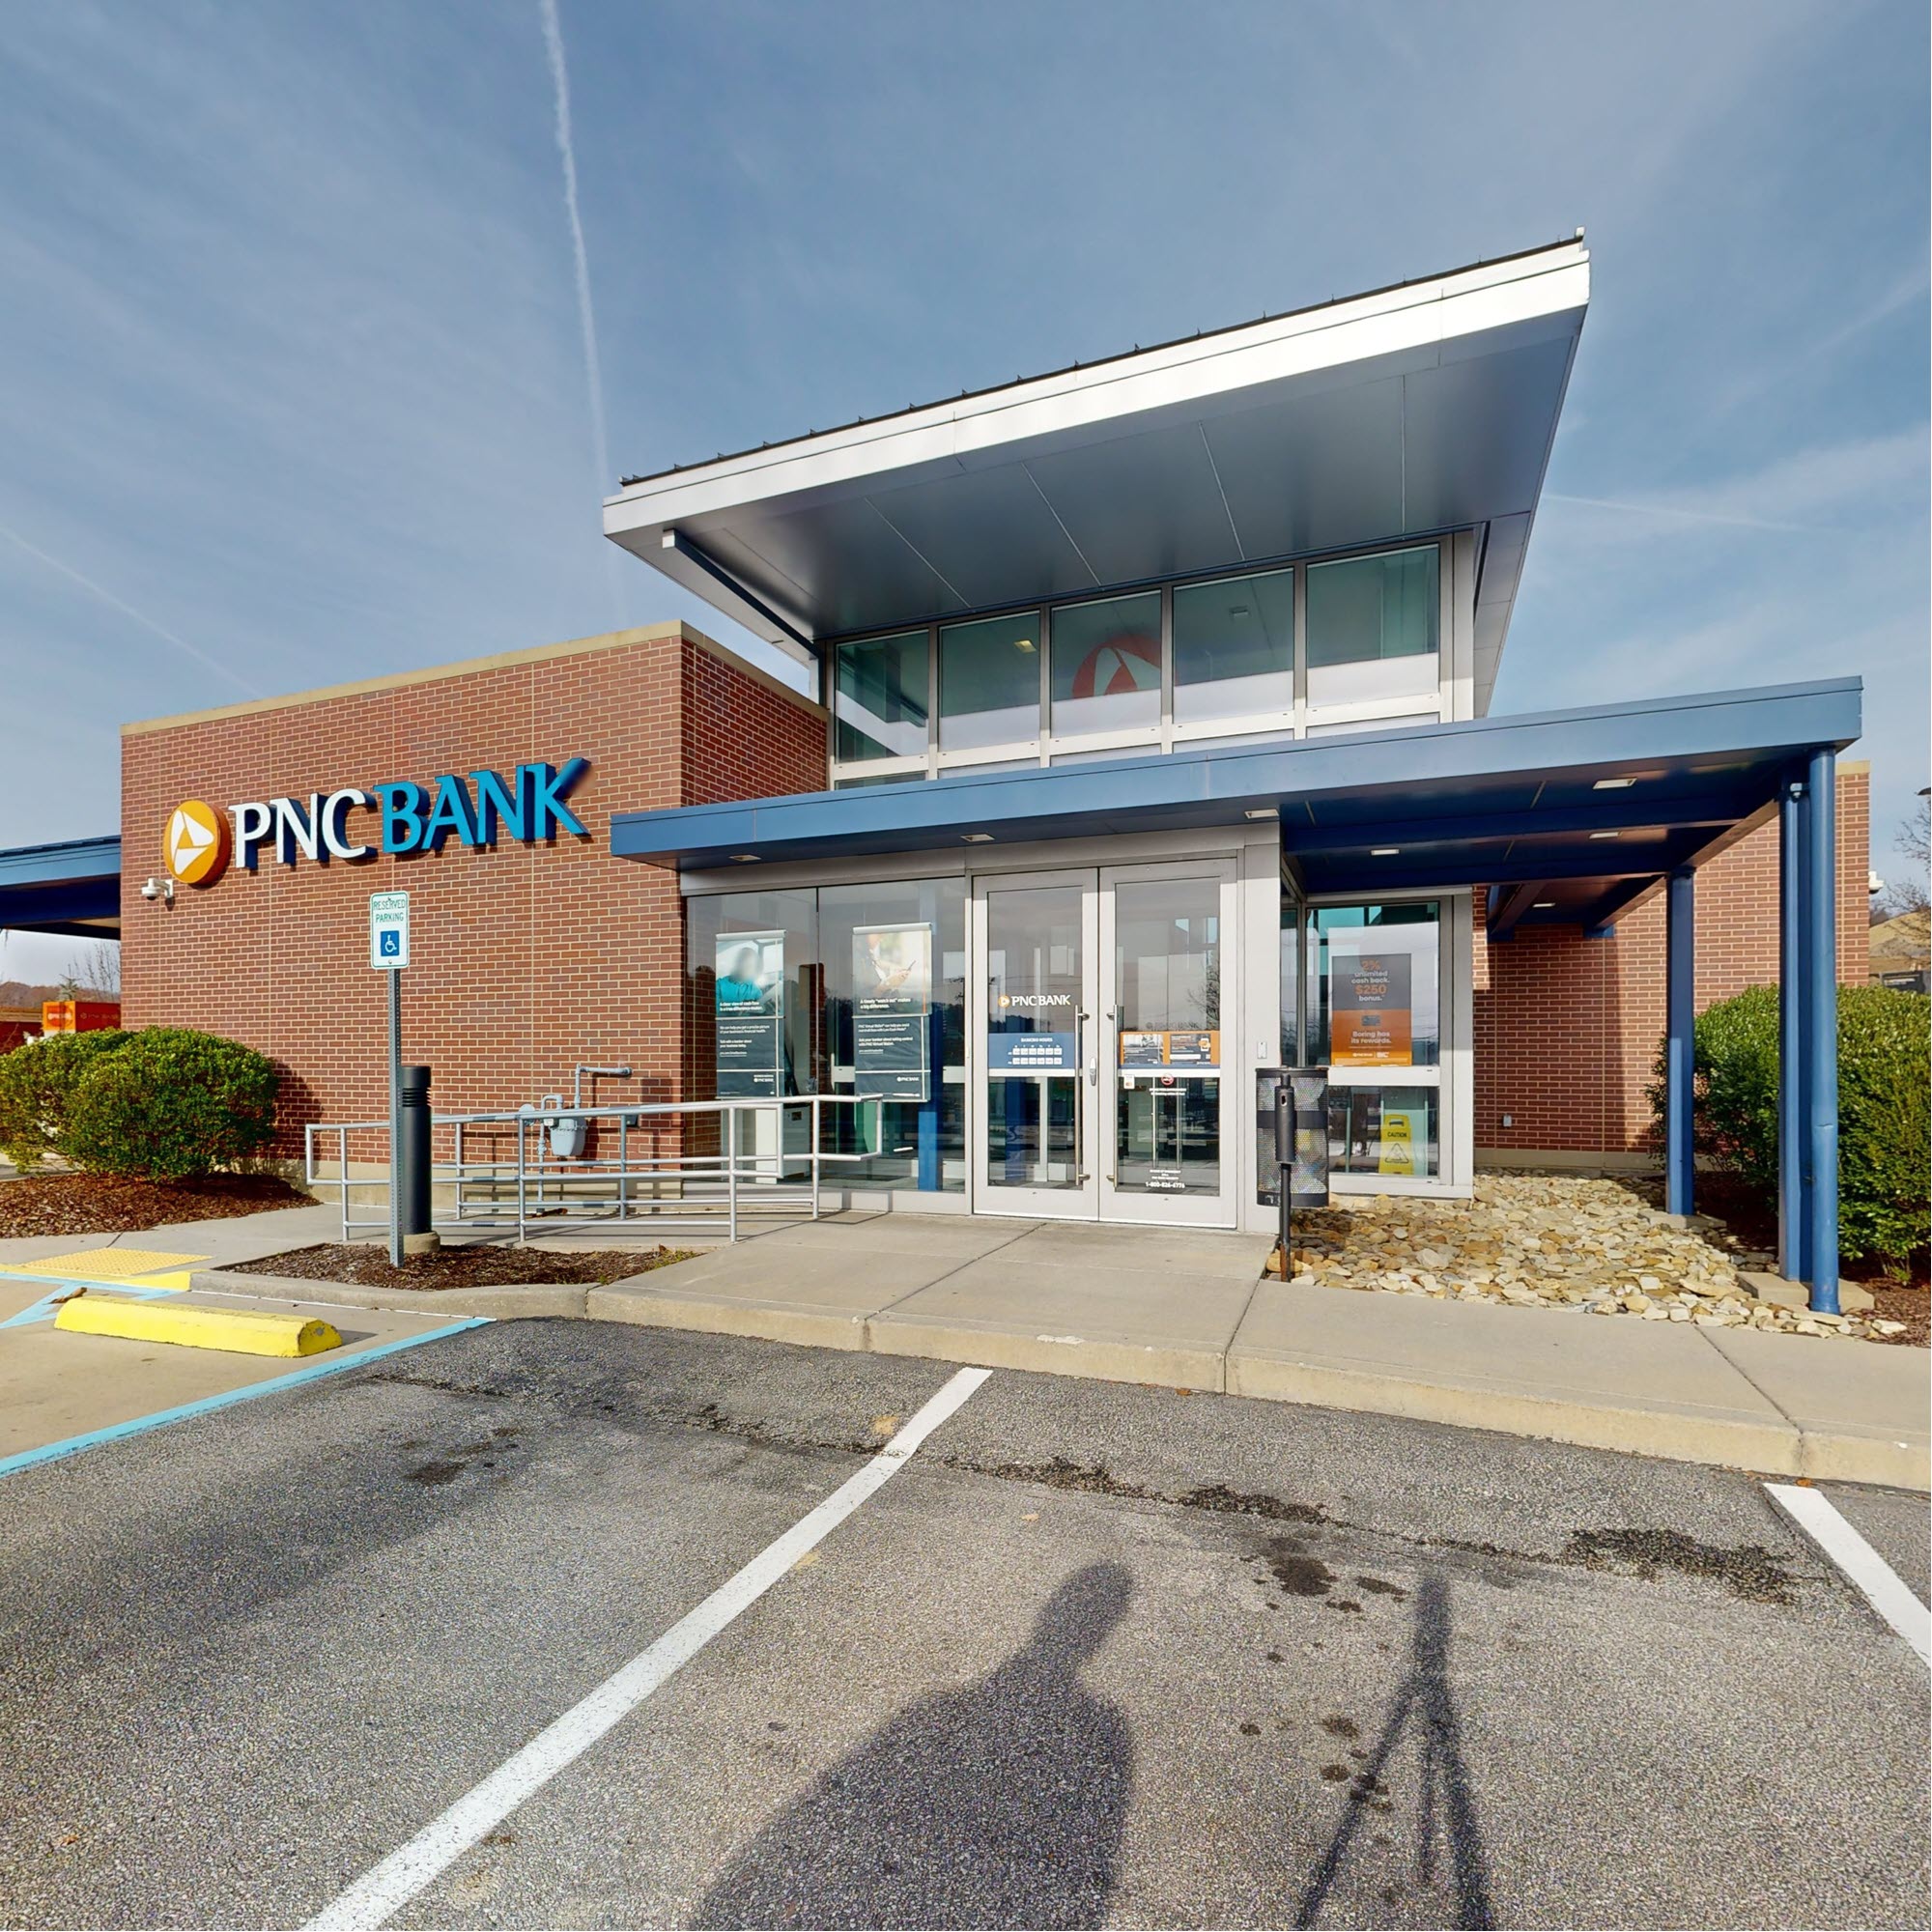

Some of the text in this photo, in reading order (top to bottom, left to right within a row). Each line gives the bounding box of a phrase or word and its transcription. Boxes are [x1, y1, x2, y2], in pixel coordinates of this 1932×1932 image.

[228, 757, 591, 869] PNC BANK
[373, 899, 406, 910] RESERVED
[375, 912, 404, 923] PARKING
[1354, 983, 1387, 995] $250
[1011, 994, 1071, 1007] PNC BANK
